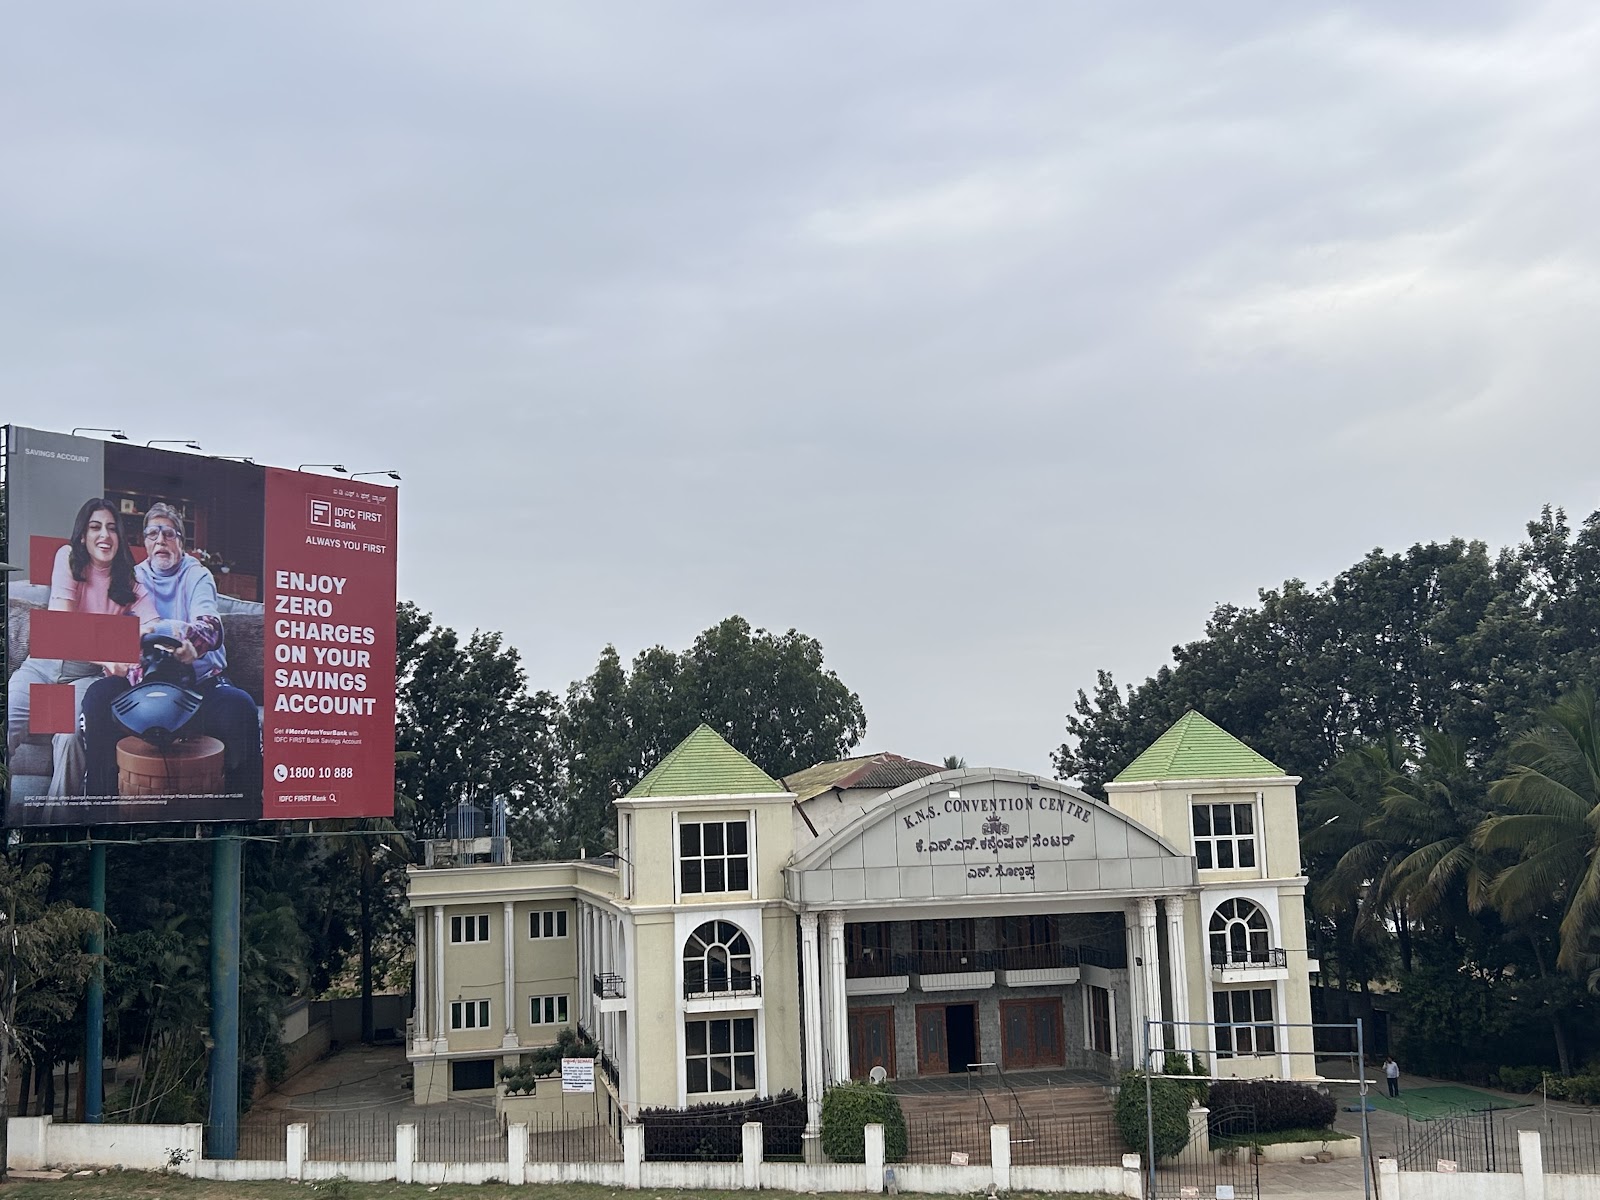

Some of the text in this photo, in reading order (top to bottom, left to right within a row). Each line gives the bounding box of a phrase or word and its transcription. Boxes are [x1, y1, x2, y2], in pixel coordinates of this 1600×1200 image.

[25, 448, 89, 462] SAVINGS ACCOUNT
[335, 507, 382, 522] IDFC FIRST
[335, 519, 356, 530] Bank
[306, 536, 386, 553] ALWAYS YOU FIRST
[276, 571, 346, 594] ENJOY
[275, 595, 332, 617] ZERO
[275, 620, 375, 644] CHARGES
[275, 644, 370, 668] ON YOUR
[275, 669, 367, 692] SAVINGS
[274, 694, 376, 715] ACCOUNT
[290, 767, 353, 778] 1800 10 888
[903, 797, 1091, 829] K.N.S. CONVENTION CENTRE
[1032, 833, 1075, 847] ಸೆಂಟರ್
